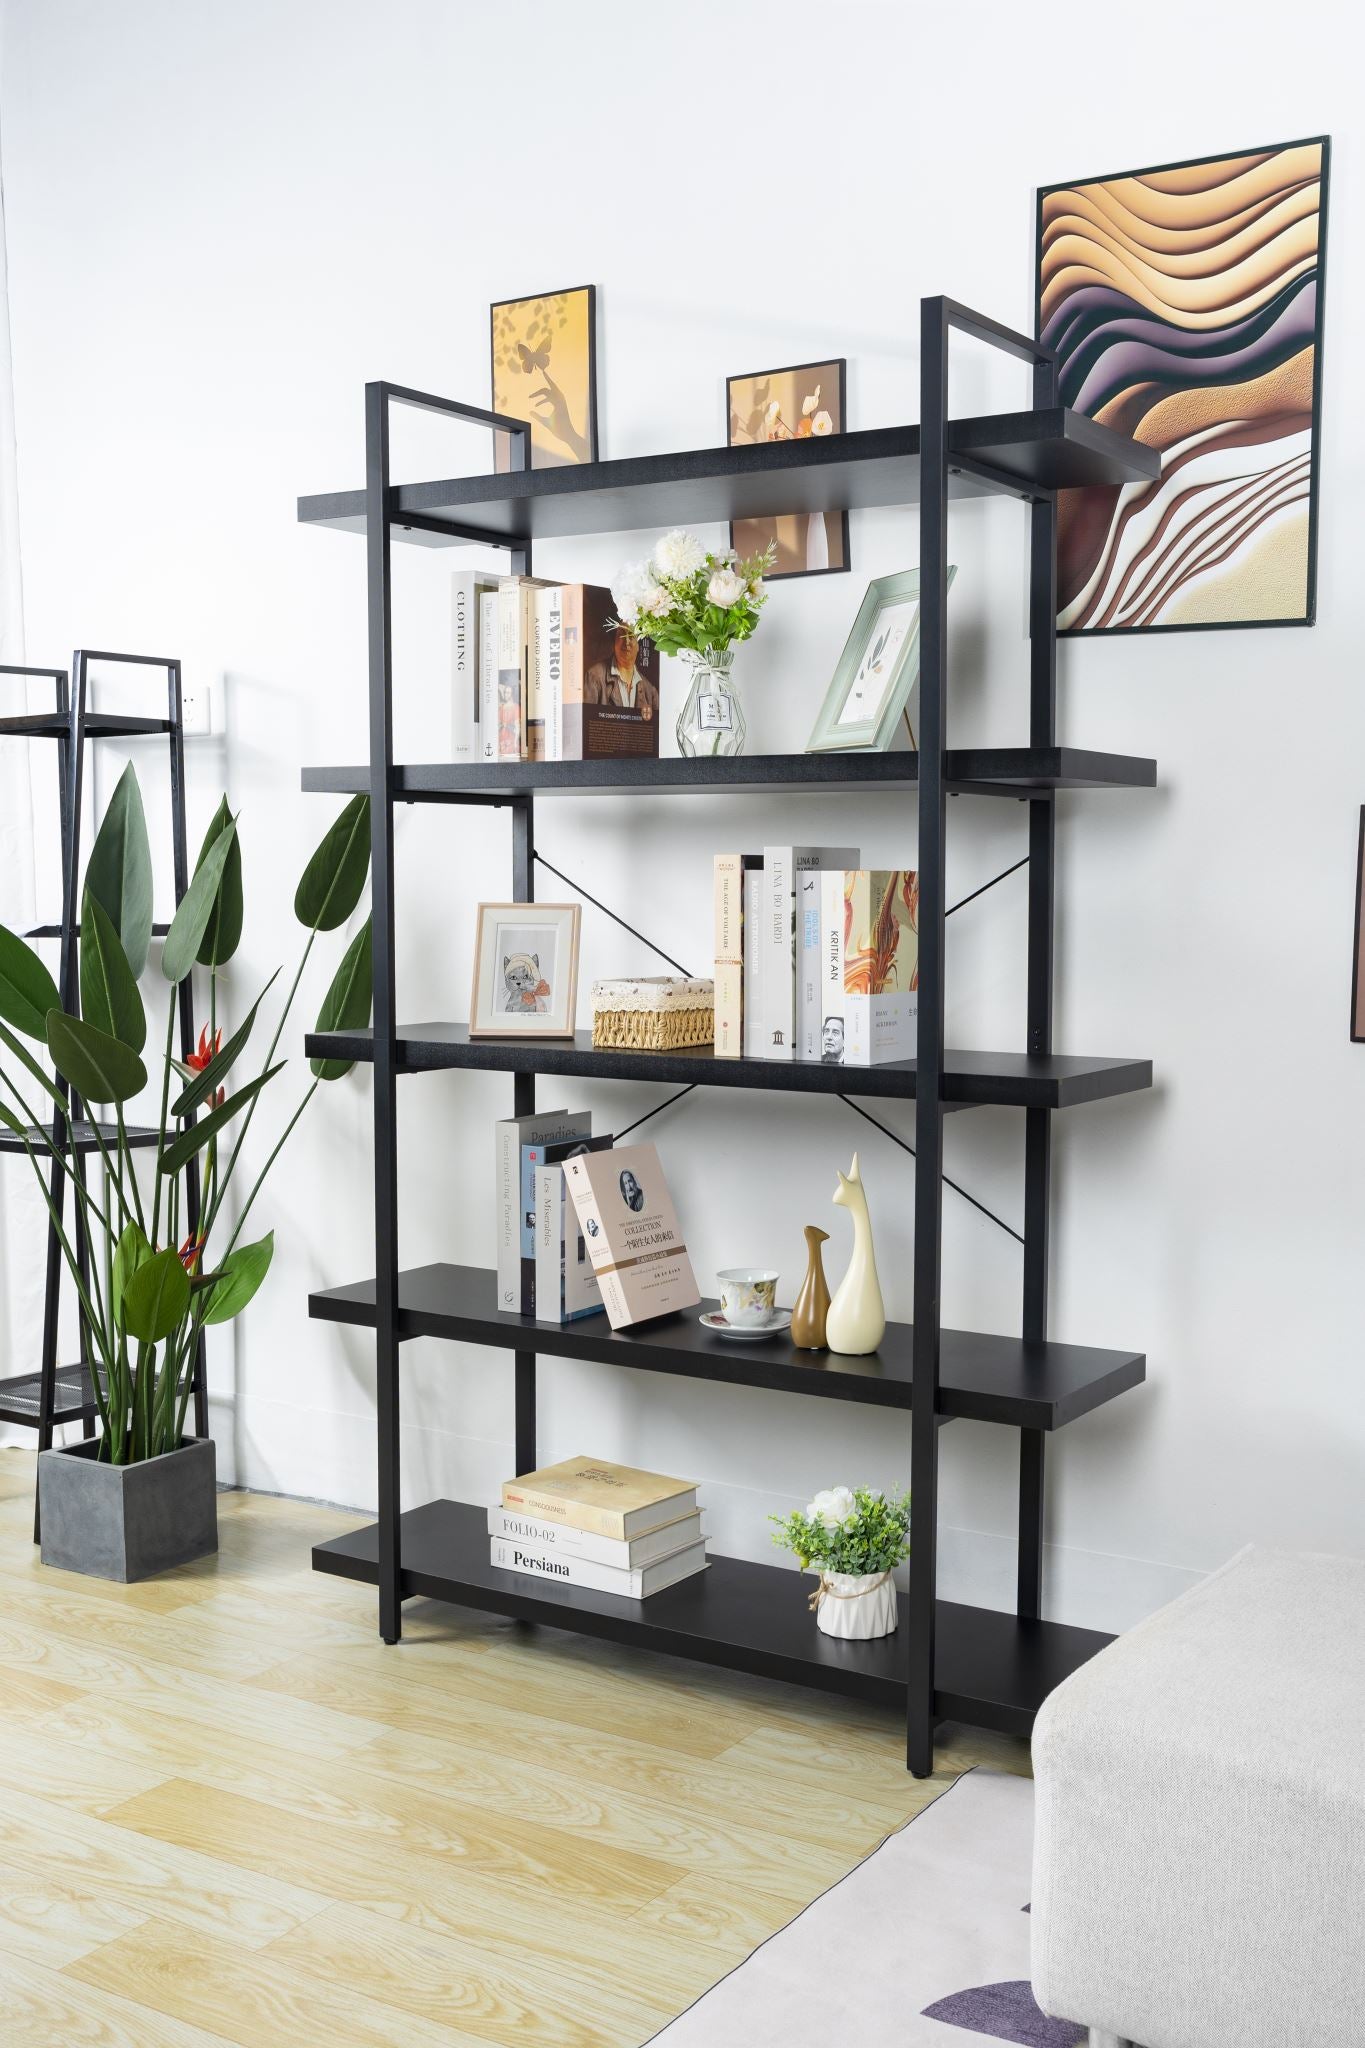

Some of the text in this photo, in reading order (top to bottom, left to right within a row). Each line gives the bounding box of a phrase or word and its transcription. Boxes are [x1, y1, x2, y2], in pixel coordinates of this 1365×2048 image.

[457, 591, 465, 671] CLOTHING
[549, 610, 561, 680] EVERO
[797, 857, 810, 865] LINA
[723, 907, 729, 916] OF
[773, 862, 782, 944] LINA BO BARDI
[830, 930, 838, 980] KRITIK AN
[543, 1177, 552, 1194] Les
[503, 1519, 555, 1543] FOLIO-02
[513, 1550, 570, 1576] Persiana
